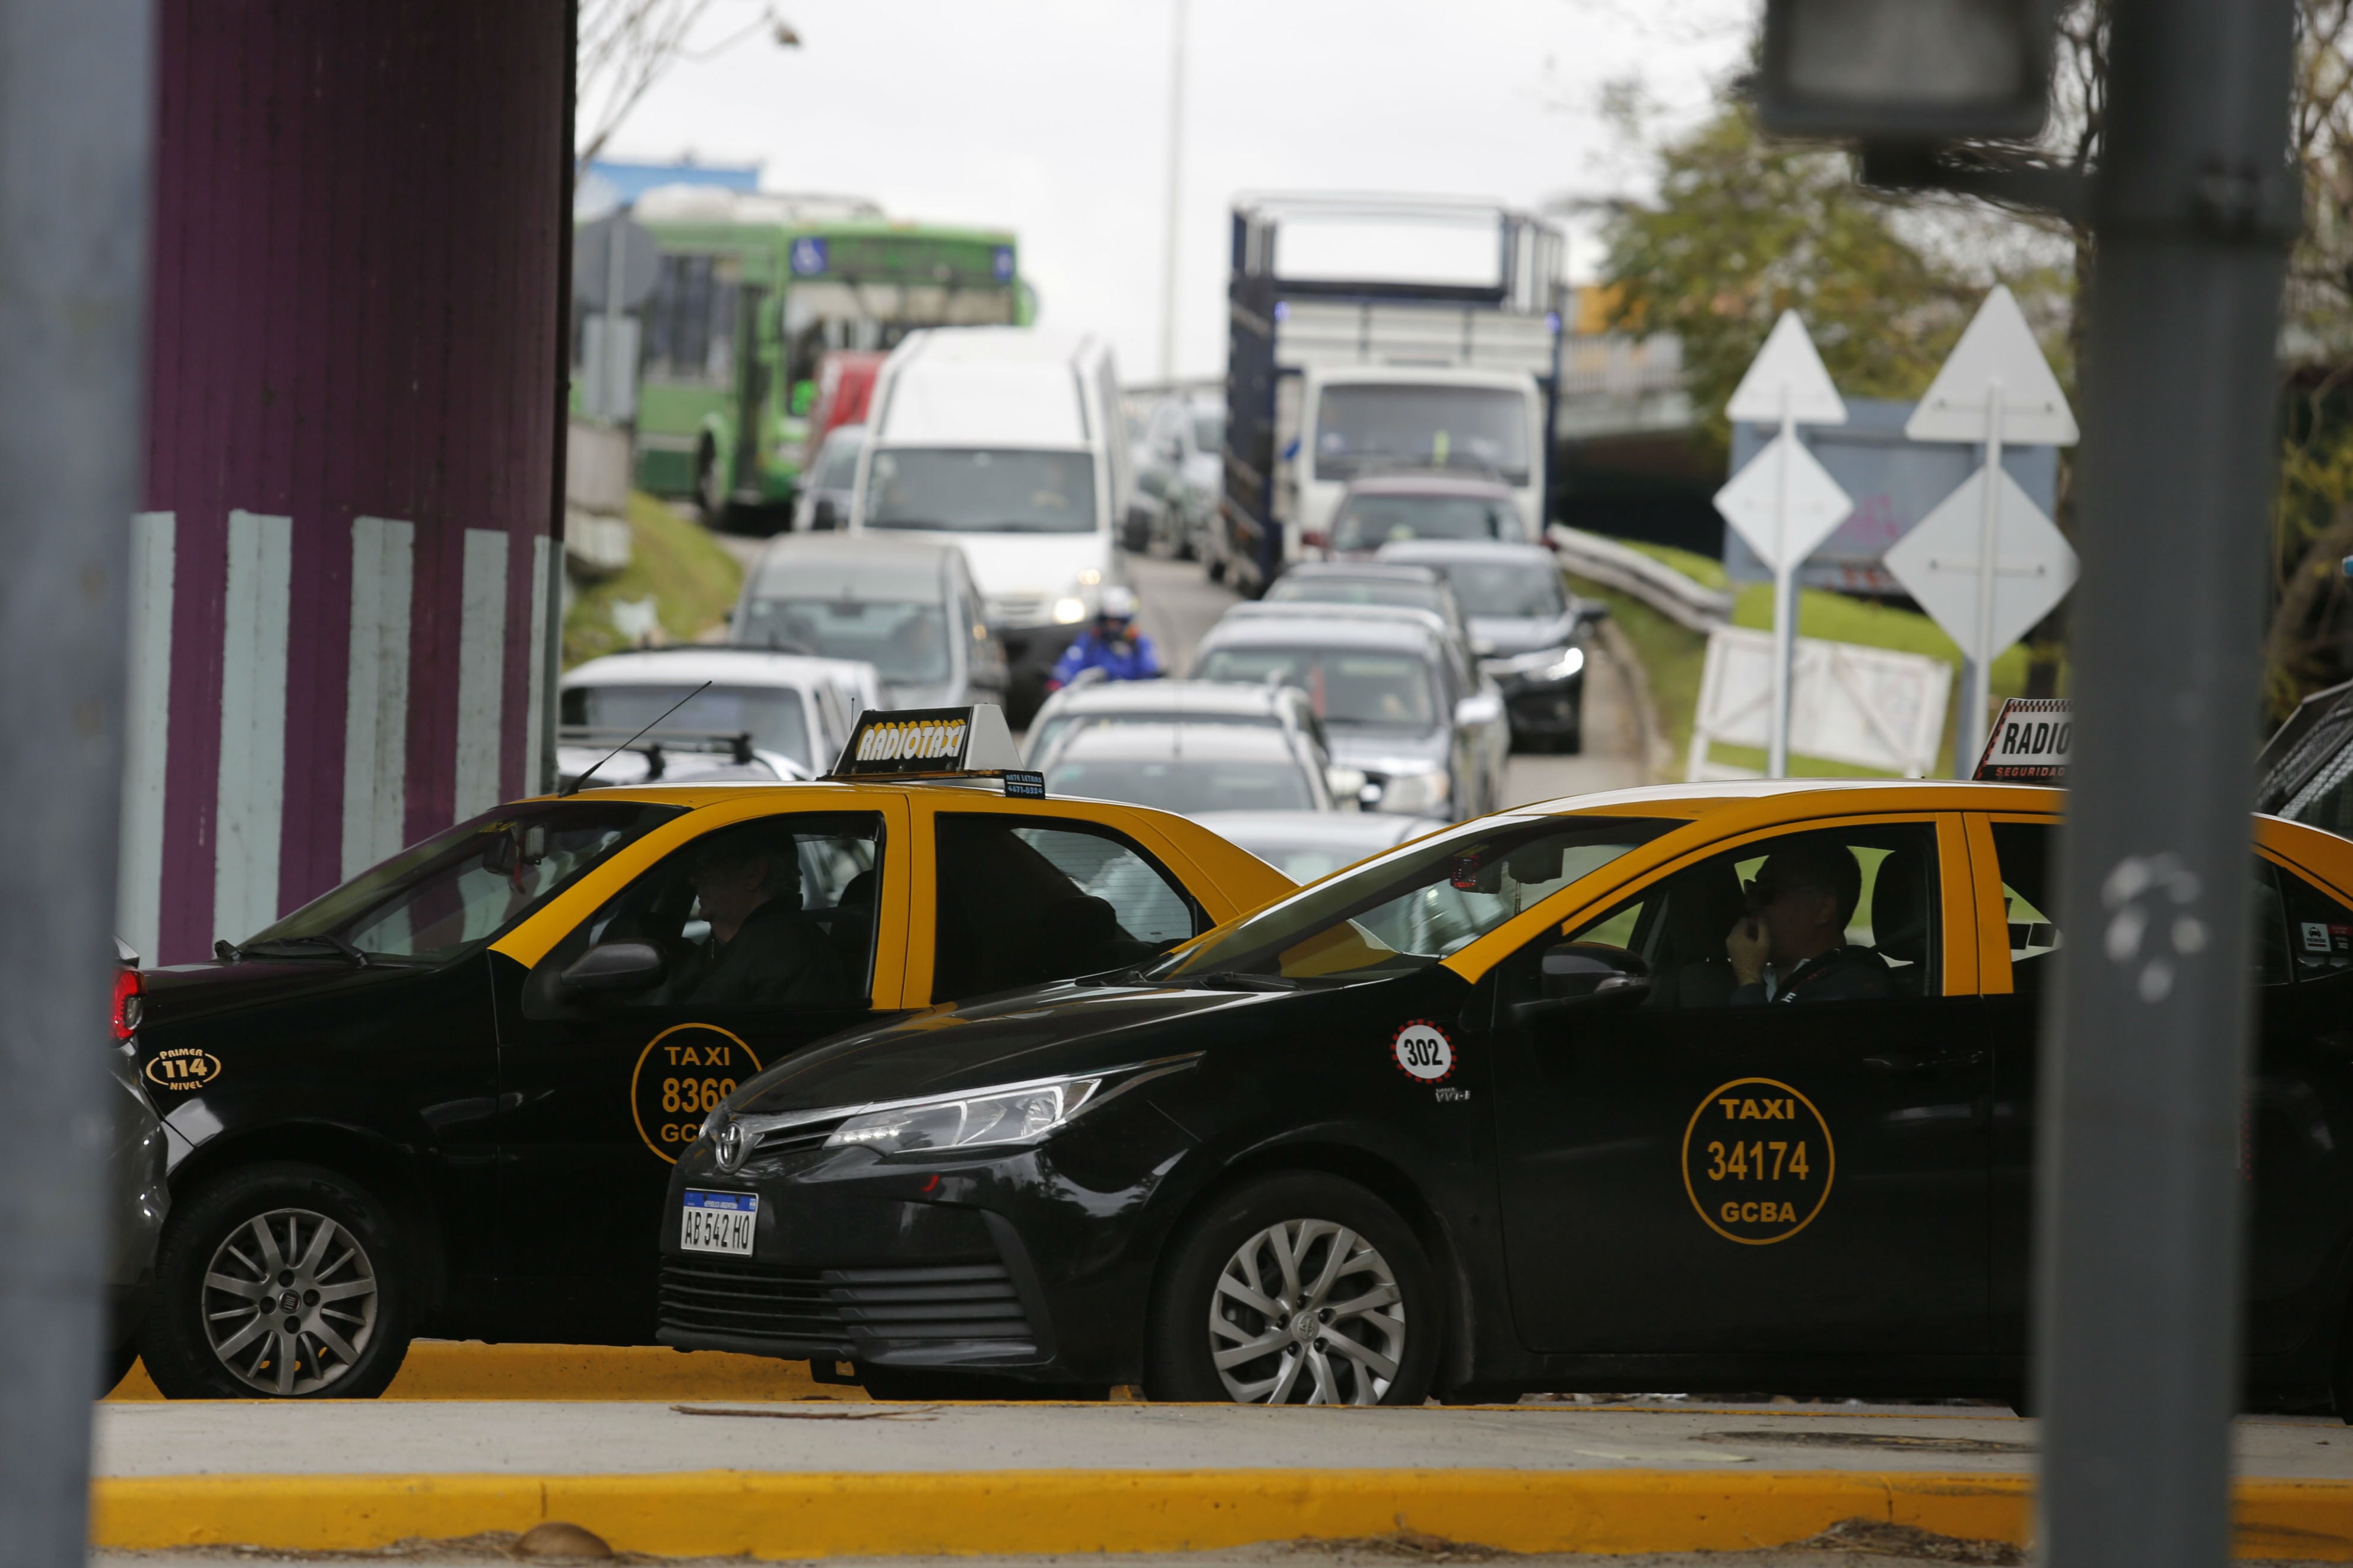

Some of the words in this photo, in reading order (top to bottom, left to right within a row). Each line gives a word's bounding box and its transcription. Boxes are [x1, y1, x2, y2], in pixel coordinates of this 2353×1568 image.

[855, 720, 966, 760] RADIOTAXI
[2002, 722, 2073, 754] RADIO
[1996, 767, 2065, 776] SEGURIDAD
[160, 1048, 203, 1059] PRIMER
[664, 1047, 730, 1066] TAXI
[1404, 1039, 1443, 1067] 302
[162, 1058, 207, 1078] 114
[170, 1081, 202, 1090] NIVEL
[1719, 1099, 1794, 1119] TAXI
[661, 1123, 703, 1142] GC
[1707, 1141, 1809, 1181] 34174
[1721, 1201, 1797, 1223] GCBA
[685, 1211, 701, 1245] AB
[705, 1212, 729, 1247] 542
[284, 1295, 296, 1309] FIAT
